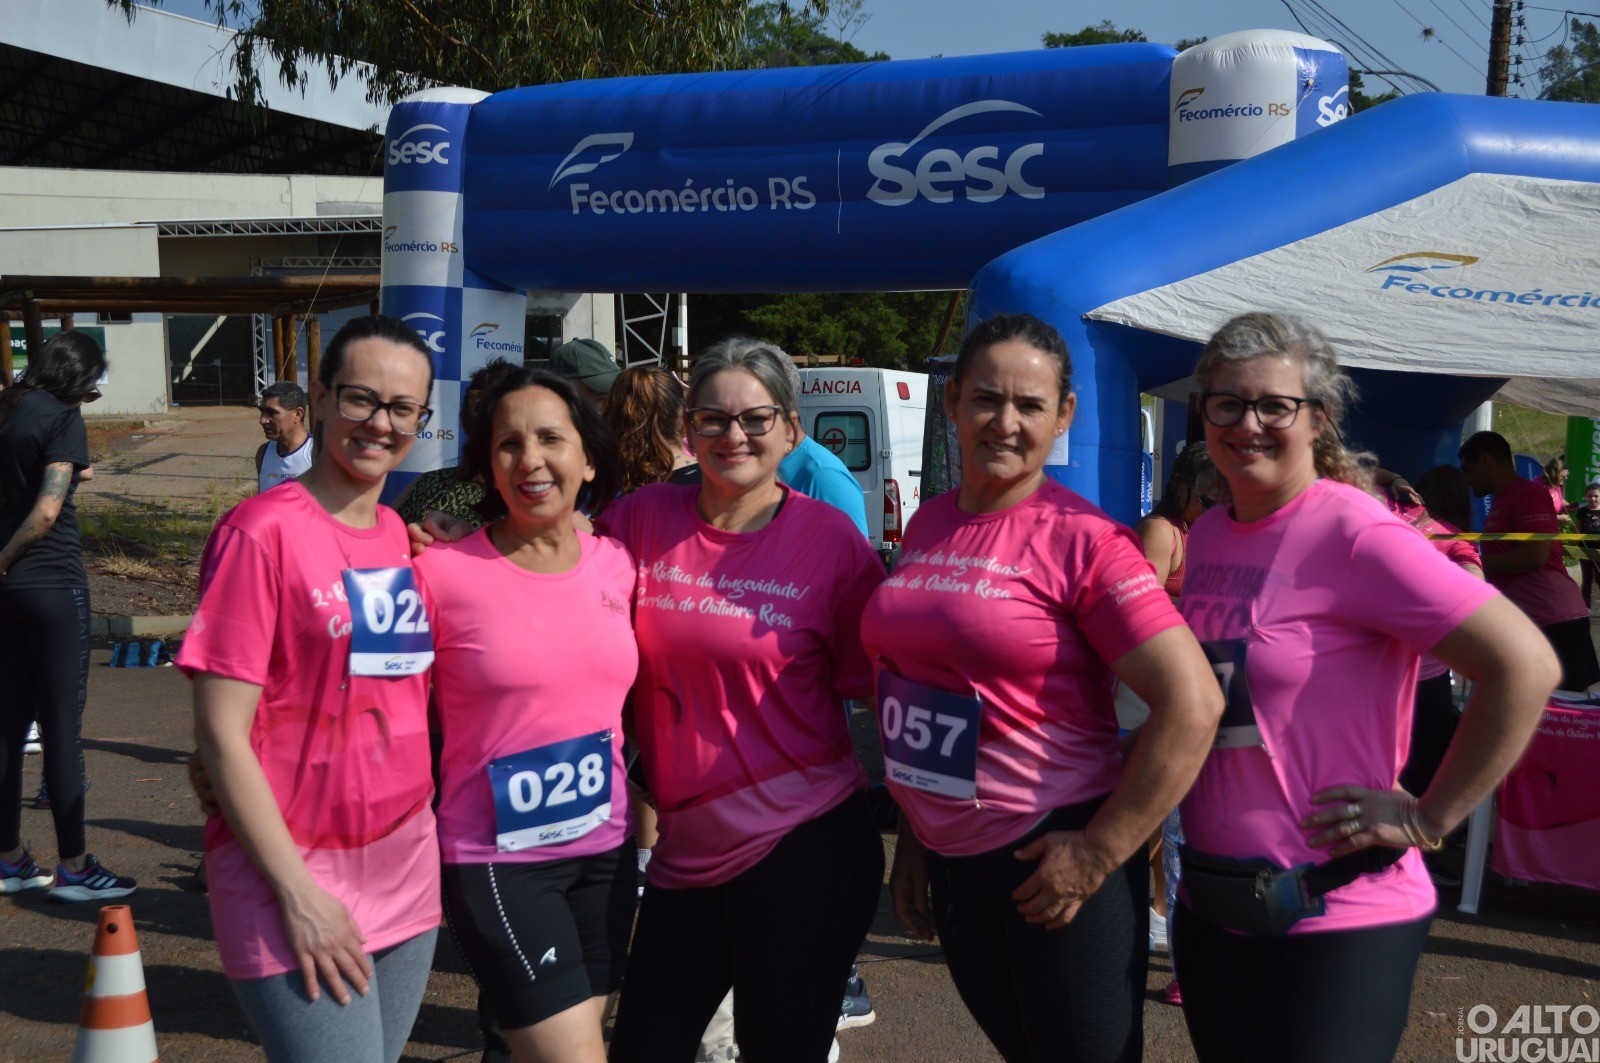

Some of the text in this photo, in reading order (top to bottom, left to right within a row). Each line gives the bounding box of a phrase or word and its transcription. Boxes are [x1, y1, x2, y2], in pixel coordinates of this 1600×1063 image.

[1180, 103, 1290, 122] Fecomércio RS
[388, 140, 450, 165] Sesc
[865, 141, 1045, 206] Sesc
[570, 176, 817, 214] Fecomércio RS
[384, 240, 459, 253] Fecomércio RS
[436, 429, 455, 440] RS
[974, 578, 1013, 599] Rosa
[759, 602, 794, 629] Rosa
[882, 696, 968, 758] 057
[508, 753, 605, 814] 028
